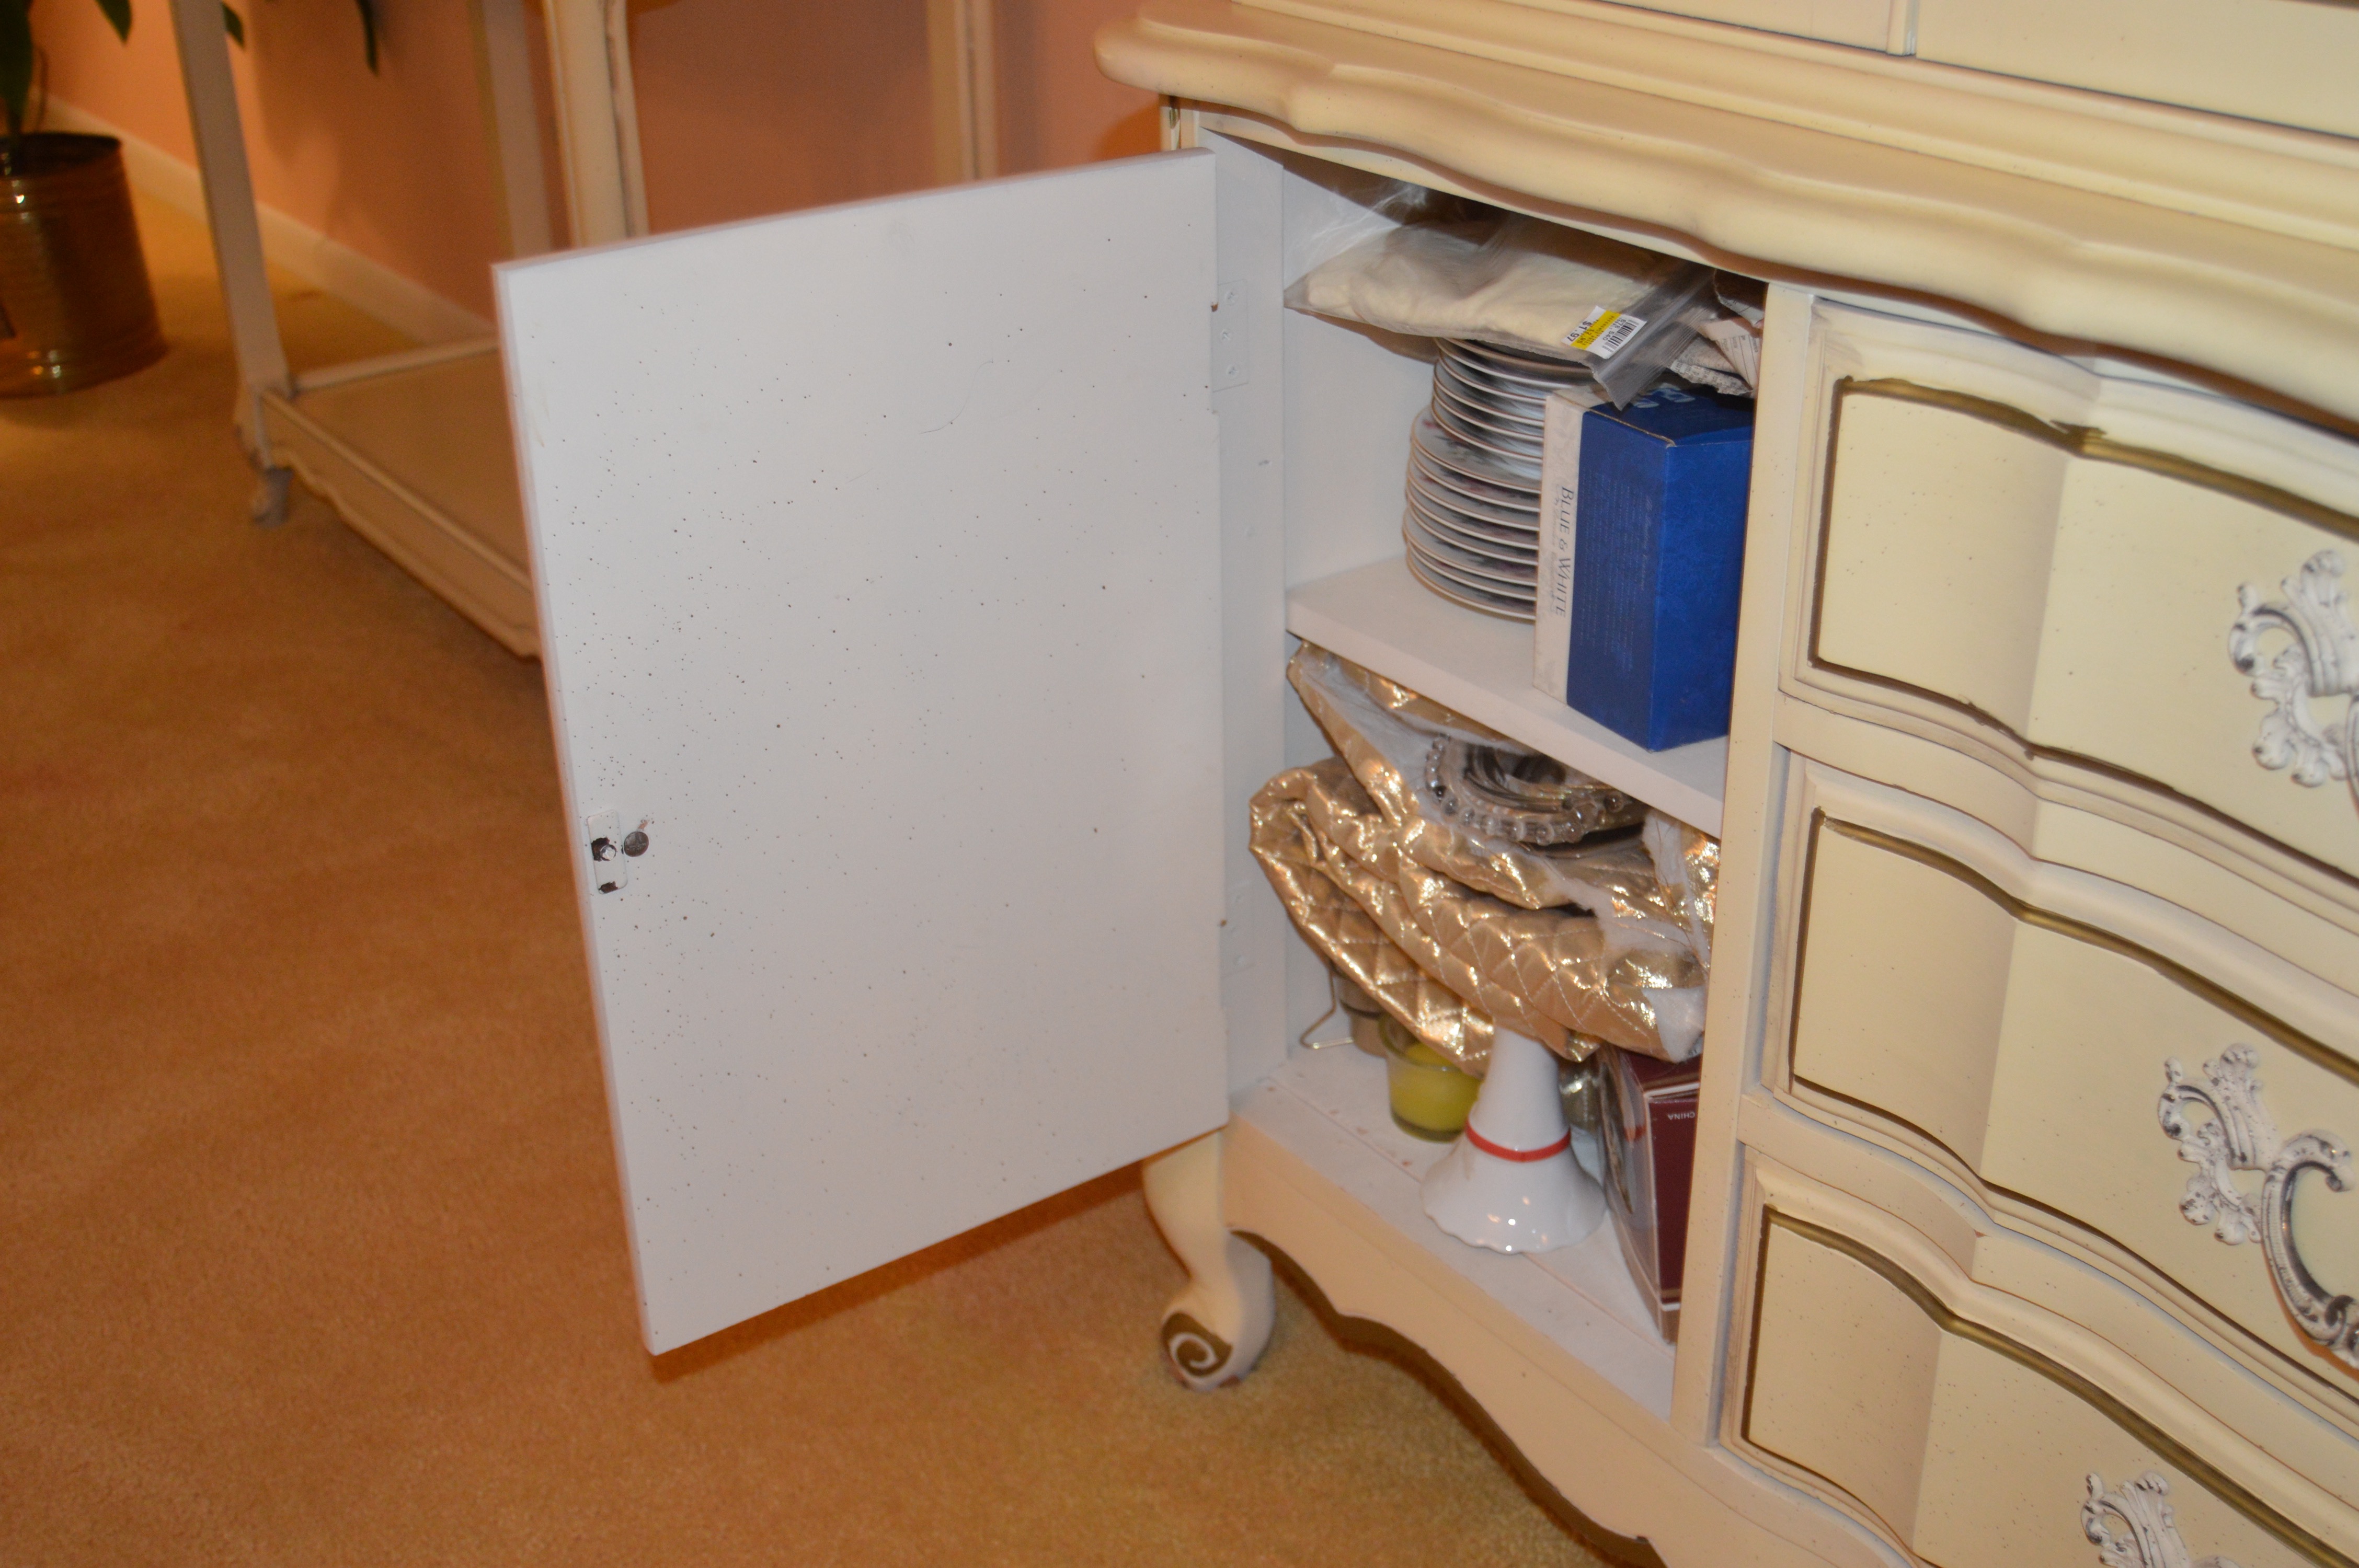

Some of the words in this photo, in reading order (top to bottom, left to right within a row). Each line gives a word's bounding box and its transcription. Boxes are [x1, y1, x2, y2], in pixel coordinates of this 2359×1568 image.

[1567, 321, 1591, 342] $1.97
[1602, 331, 1614, 341] 540
[1561, 487, 1573, 534] BLUE
[1560, 538, 1568, 552] &
[1556, 558, 1571, 617] WHITE
[1668, 1112, 1695, 1120] CHINA
